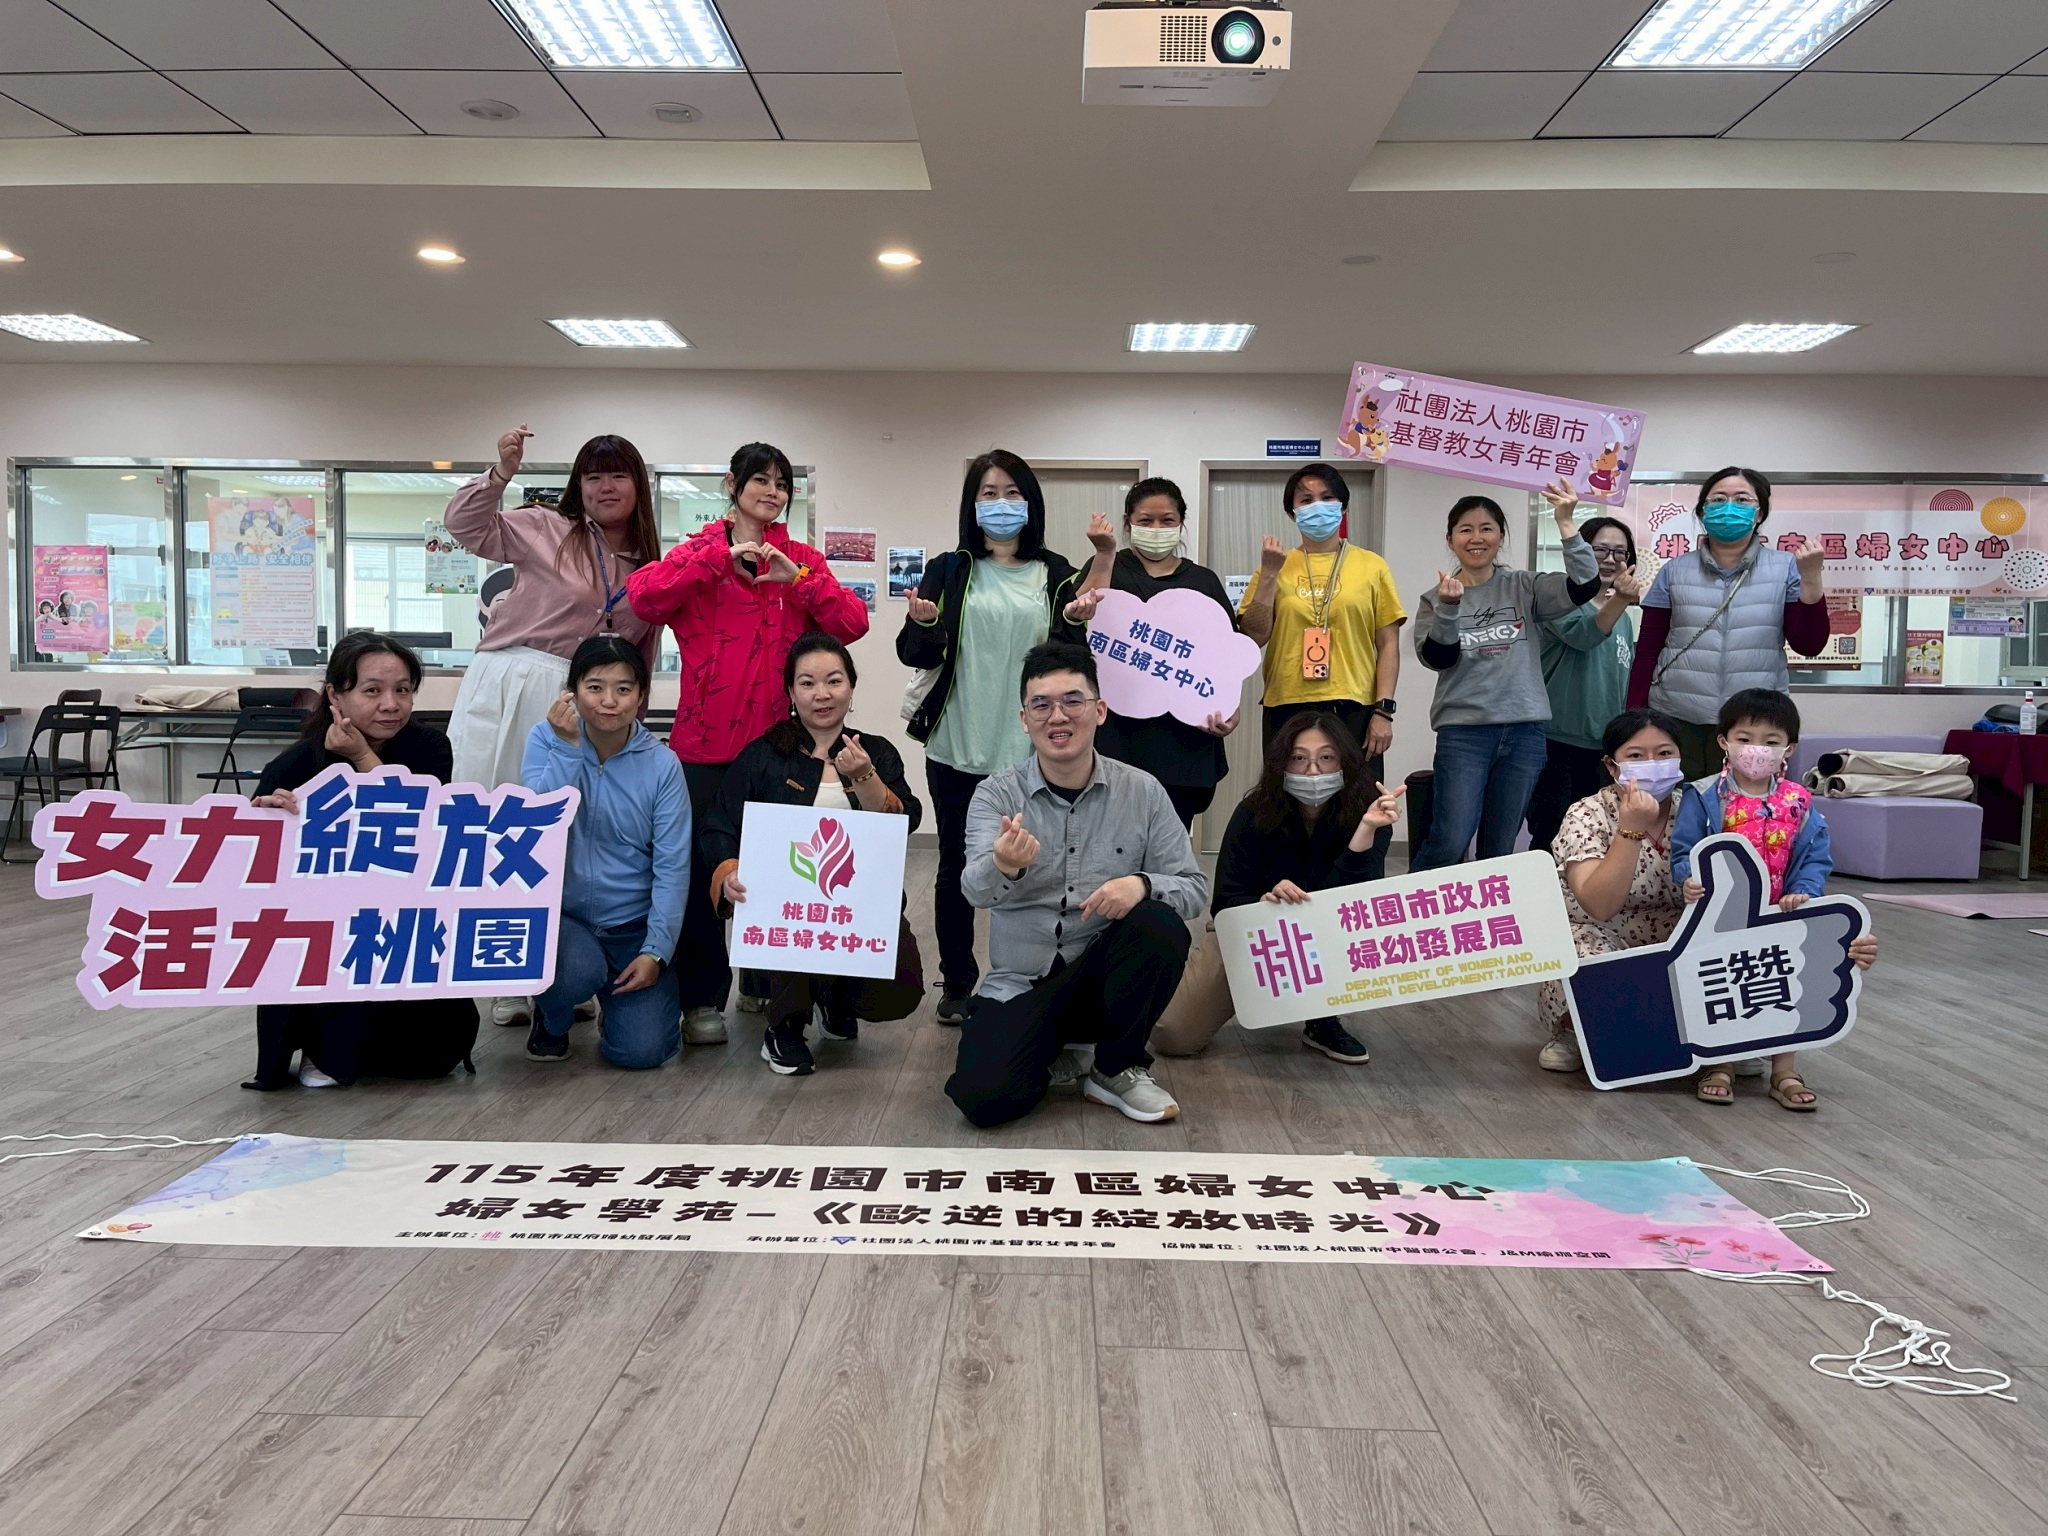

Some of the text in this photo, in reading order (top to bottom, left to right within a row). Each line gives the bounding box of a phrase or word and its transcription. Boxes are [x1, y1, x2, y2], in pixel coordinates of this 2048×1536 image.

[1395, 388, 1589, 443] 社團法人桃園市
[1389, 420, 1581, 476] 基督教女青年會
[266, 553, 314, 566] 安全相伴
[1654, 532, 2010, 561] 桃南區婦女中心
[1129, 618, 1195, 659] 桃園市
[1088, 630, 1215, 698] 南區婦女中心
[53, 773, 571, 889] 女力綻放
[782, 901, 854, 925] 桃園市
[1337, 874, 1511, 933] 桃園市政府
[97, 906, 550, 993] 活力桃園
[742, 925, 888, 953] 南區婦女中心
[1347, 914, 1523, 973] 婦幼發展局
[1345, 951, 1534, 992] DEPARTMENT OF WOMEN AND
[1698, 944, 1797, 1025] 讚
[1327, 985, 1394, 1007] CHILDREN
[424, 1163, 1495, 1201] 115年度桃園市南區婦女中心
[509, 1232, 692, 1241] 桃園市政府婦幼發展局
[862, 1237, 1117, 1248] 社團法人桃園市基督教女青年會
